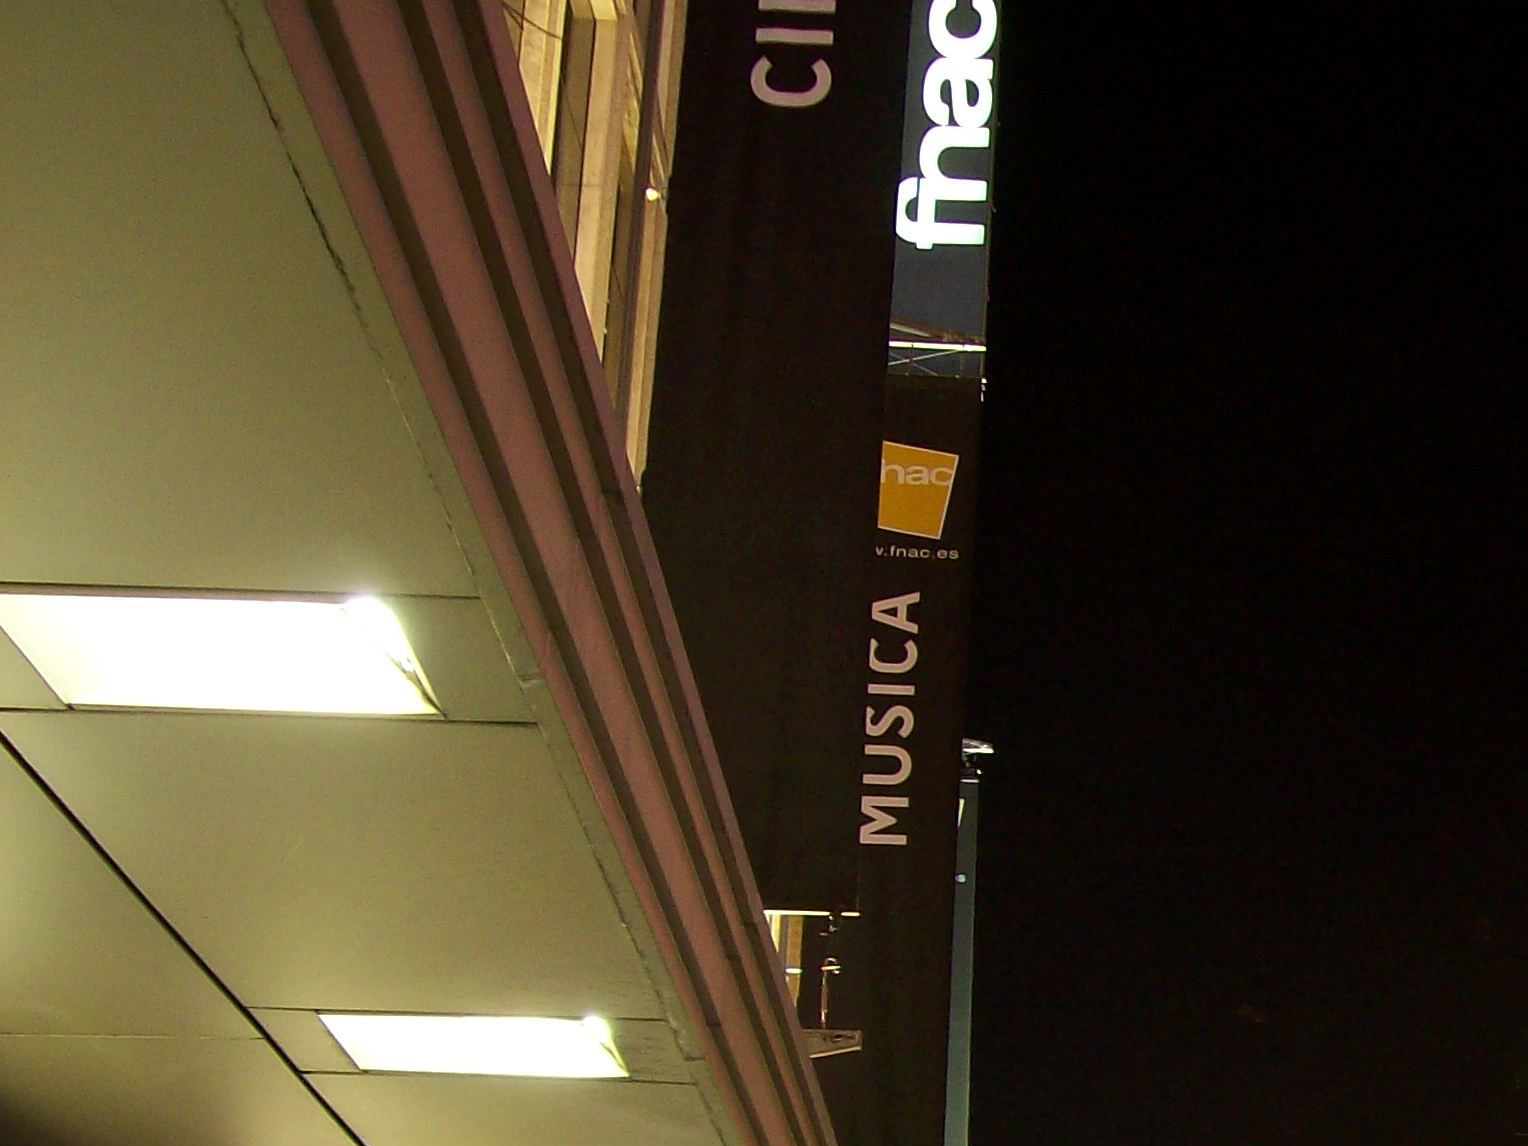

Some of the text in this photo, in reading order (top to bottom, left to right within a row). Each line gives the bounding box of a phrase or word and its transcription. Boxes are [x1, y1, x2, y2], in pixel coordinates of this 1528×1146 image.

[750, 0, 836, 107] CI
[896, 0, 998, 249] fnac
[881, 459, 953, 486] nac
[859, 592, 920, 845] MUSICA
